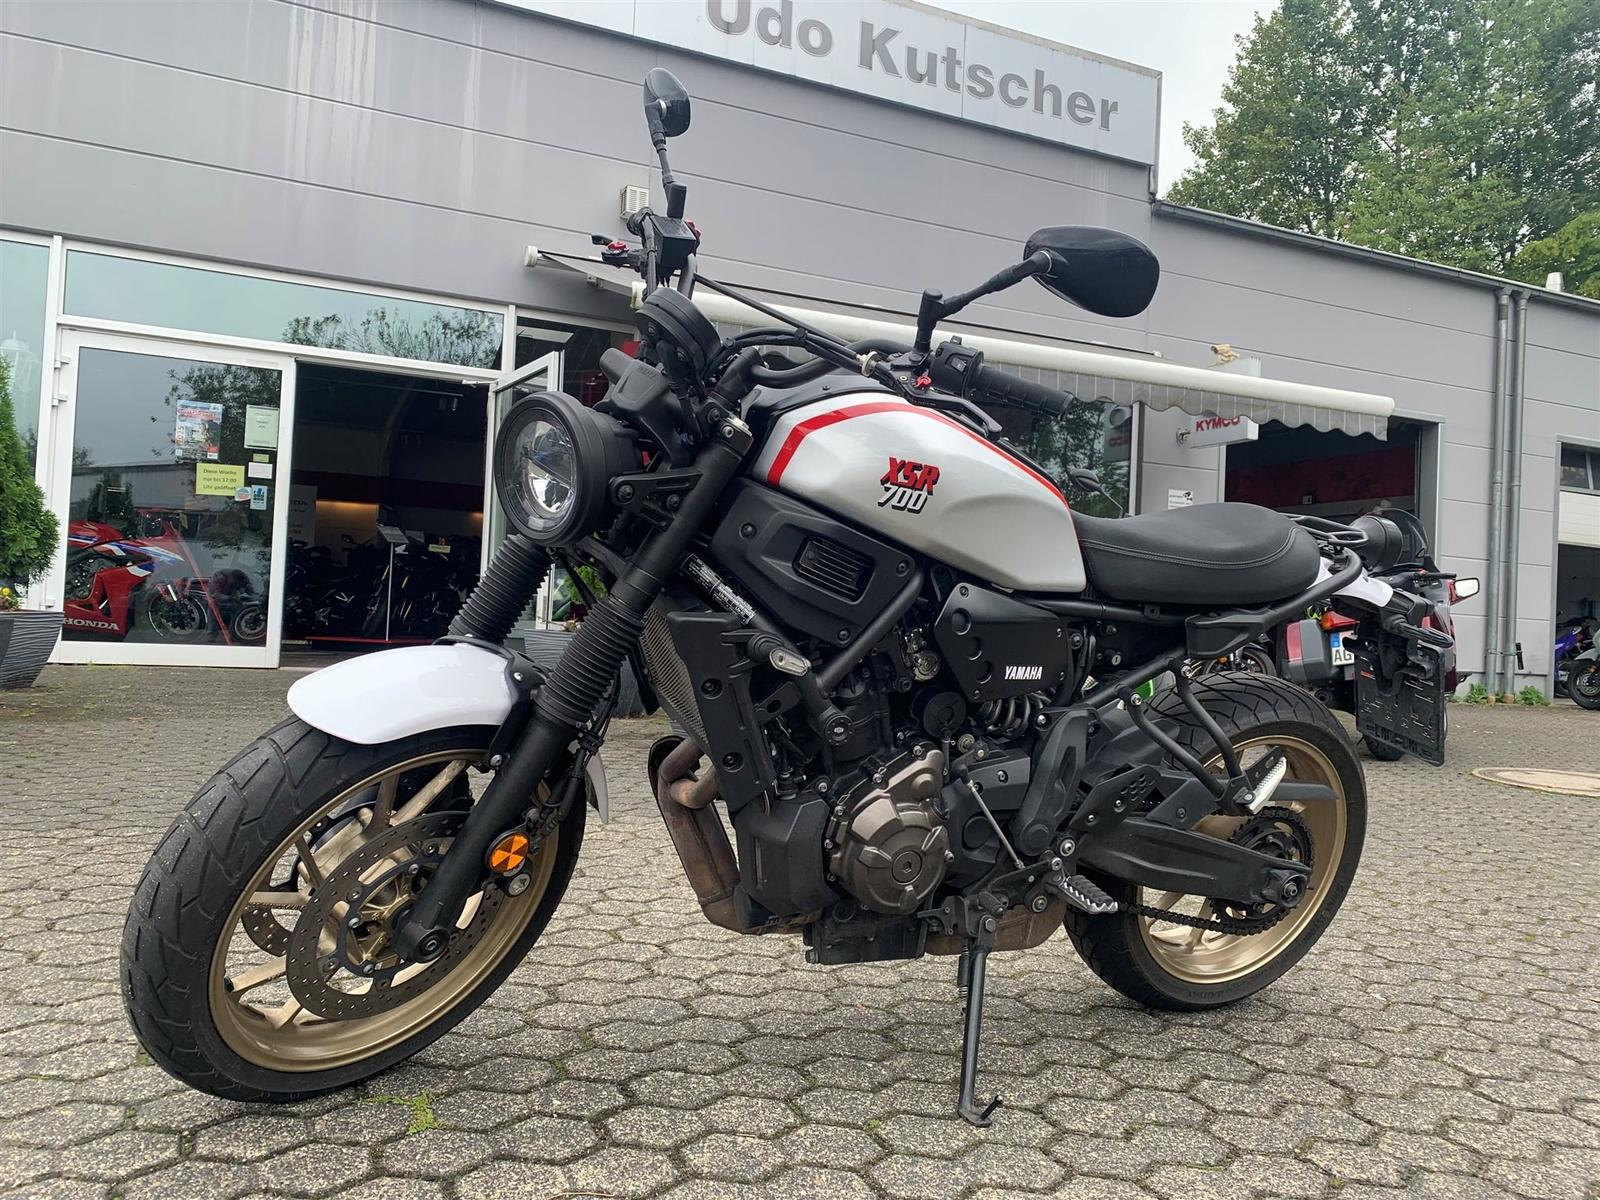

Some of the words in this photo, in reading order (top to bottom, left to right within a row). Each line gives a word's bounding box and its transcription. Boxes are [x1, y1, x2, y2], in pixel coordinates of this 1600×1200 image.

[706, 0, 834, 57] Udo
[857, 20, 1120, 132] Kutscher
[880, 457, 940, 495] XSR
[877, 484, 928, 514] 700
[64, 617, 120, 631] HONDA
[1004, 665, 1043, 680] YAMAHA
